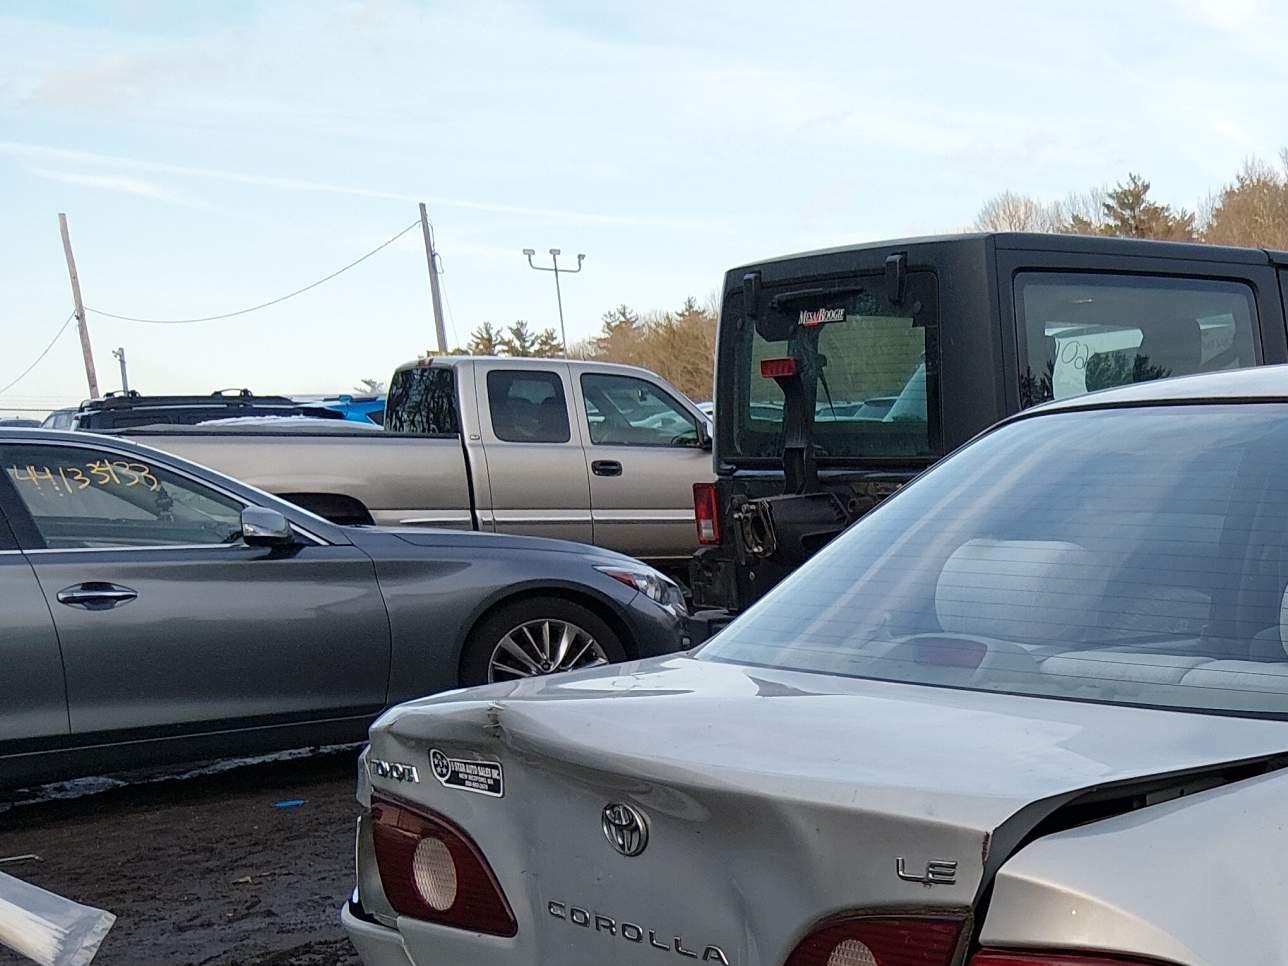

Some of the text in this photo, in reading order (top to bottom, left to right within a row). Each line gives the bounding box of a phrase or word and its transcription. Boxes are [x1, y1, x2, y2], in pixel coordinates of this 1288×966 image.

[370, 759, 420, 783] TOYOTA
[466, 764, 478, 775] AUTO
[896, 856, 958, 885] LE
[548, 899, 729, 966] COROLLA
